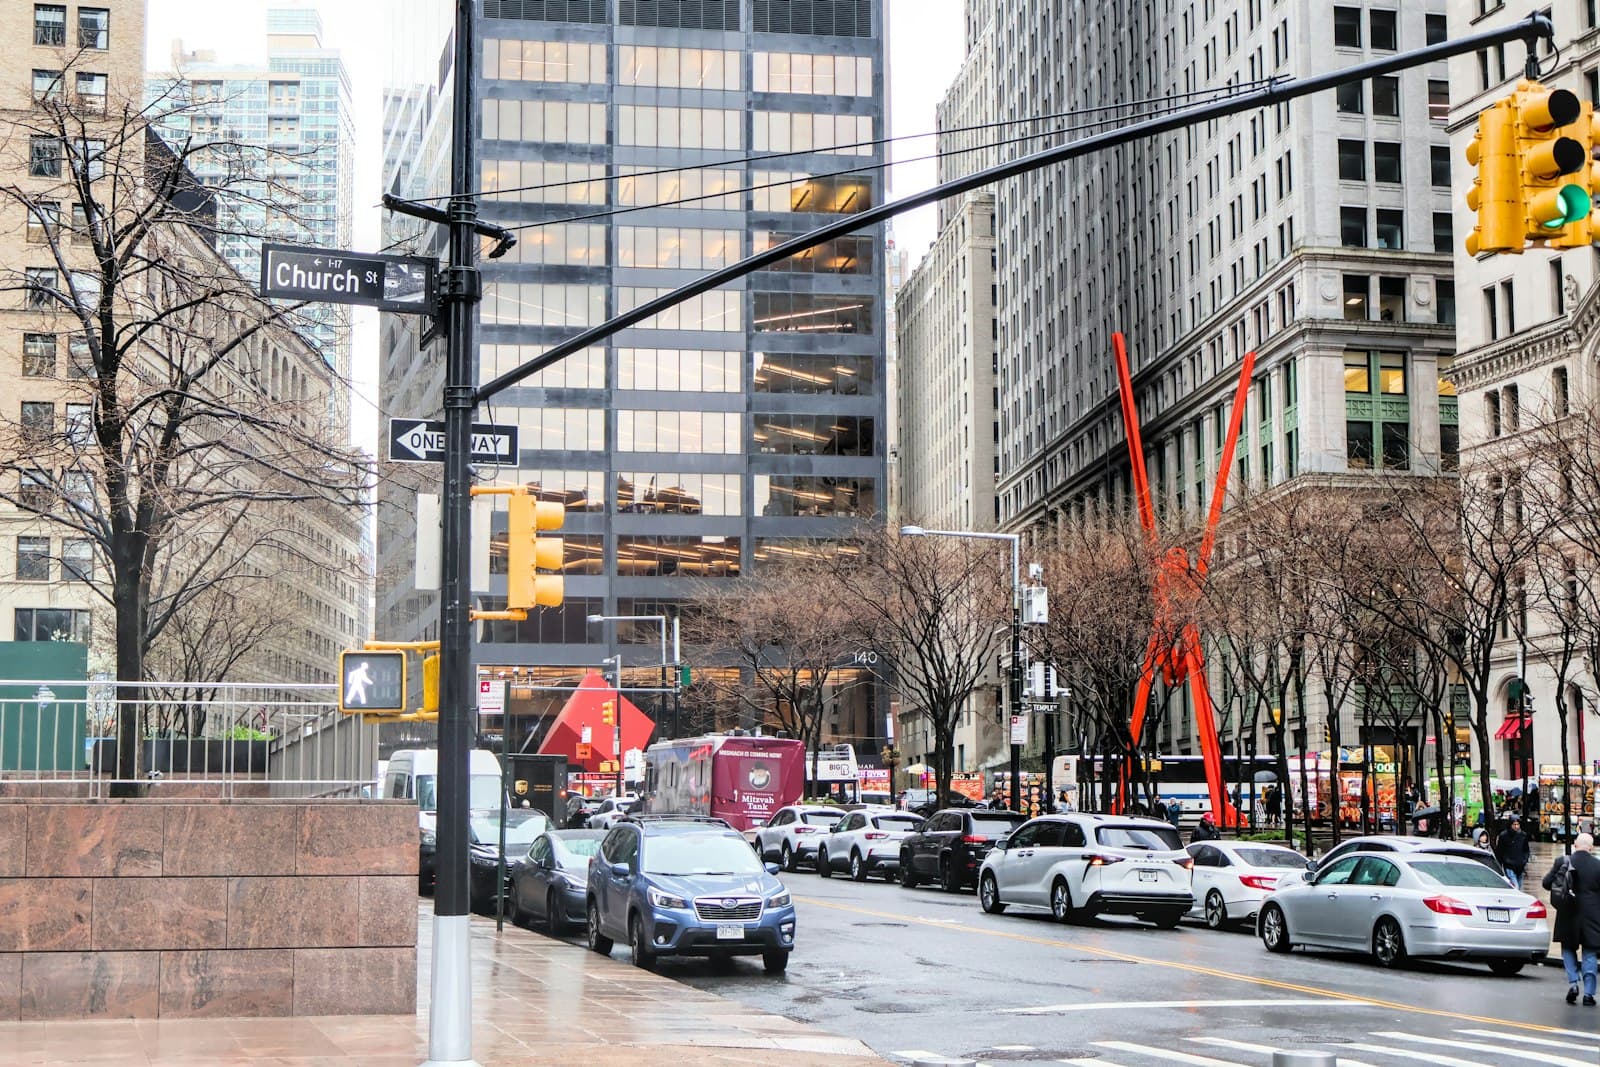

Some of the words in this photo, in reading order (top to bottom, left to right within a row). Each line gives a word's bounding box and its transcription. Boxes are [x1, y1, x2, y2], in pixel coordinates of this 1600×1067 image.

[276, 262, 360, 294] Church
[365, 270, 379, 285] St
[410, 432, 447, 449] ONE
[854, 648, 878, 664] 140
[1033, 704, 1054, 712] TEMPLE
[829, 763, 841, 771] BIG
[741, 795, 775, 804] Mitzvah
[747, 803, 768, 811] Tank
